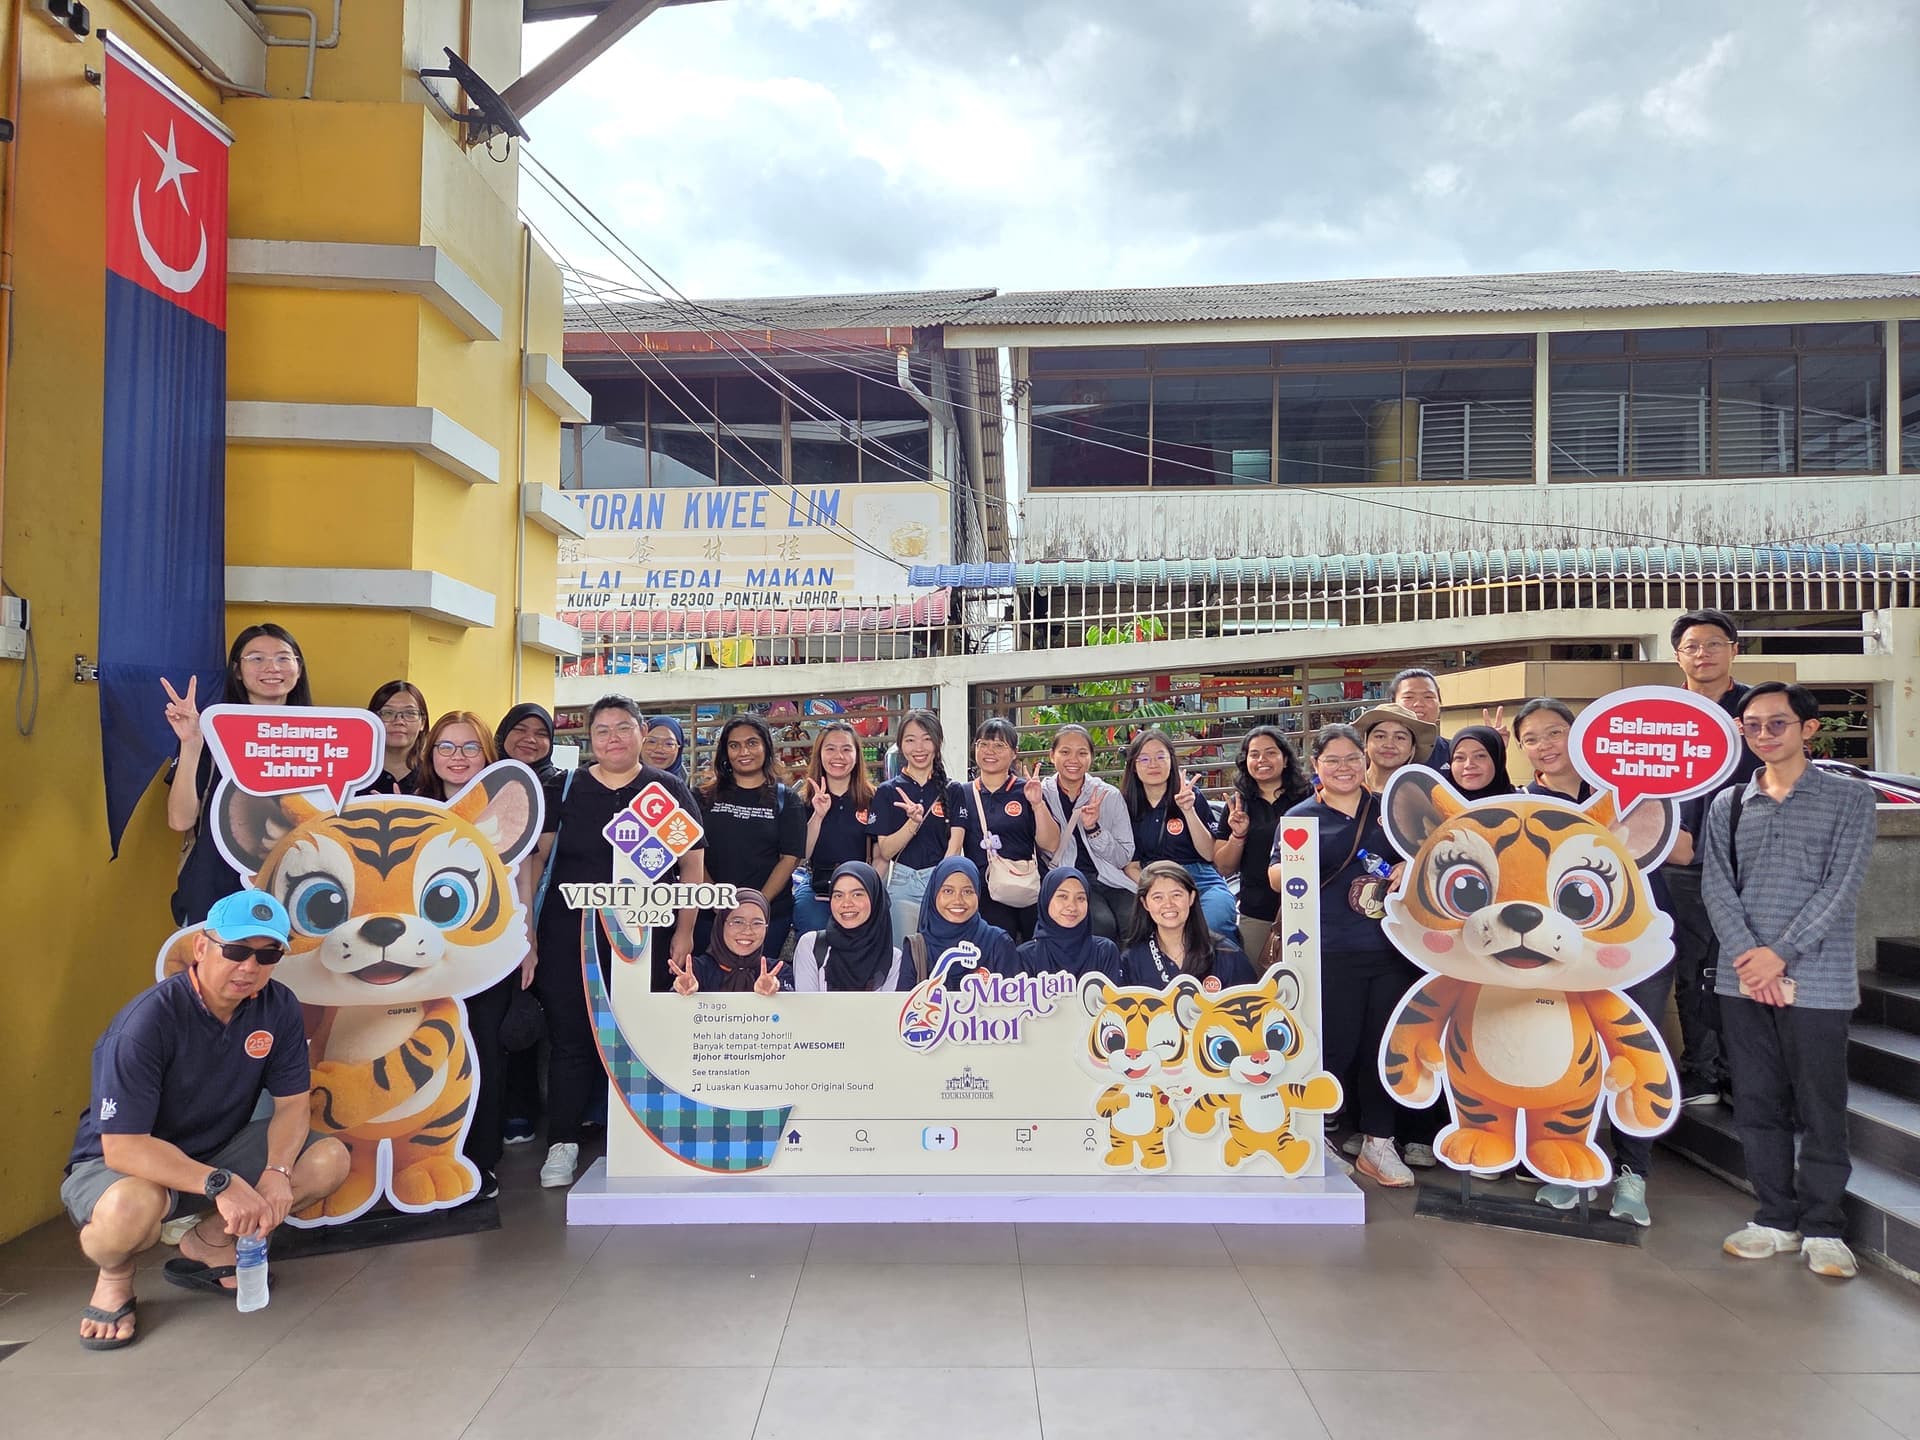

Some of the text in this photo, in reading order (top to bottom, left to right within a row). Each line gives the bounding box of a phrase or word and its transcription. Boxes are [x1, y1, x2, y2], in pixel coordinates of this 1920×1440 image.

[562, 492, 665, 530] TORAN
[684, 491, 769, 528] KWEE
[788, 489, 840, 527] LIM
[580, 567, 834, 589] LAI KEDAI MAKAN
[567, 593, 611, 607] KUKUP
[671, 592, 714, 606] 82300
[796, 590, 838, 605] JOHOR
[257, 722, 338, 739] Selamat
[1609, 717, 1699, 736] Selamat
[245, 742, 349, 762] Datang ke
[1595, 737, 1711, 762] Datang ke
[260, 762, 322, 777] Johor
[1611, 759, 1680, 778] Johor
[563, 886, 735, 907] VISIT JOHOR
[626, 910, 671, 924] 2026
[693, 1013, 770, 1024] @tourismjohor
[729, 1032, 759, 1041] datang
[761, 1032, 792, 1040] Johor!!!
[693, 1042, 723, 1050] Banyak
[793, 1042, 845, 1050] AWESOME!!
[692, 1052, 786, 1062] #johor #tourismjohor
[708, 1068, 750, 1076] translation
[706, 1083, 741, 1091] Luaskan
[743, 1083, 783, 1091] Kuasamu
[811, 1082, 845, 1091] Original
[847, 1082, 874, 1090] Sound
[941, 1091, 994, 1100] TOURISM JOHOR
